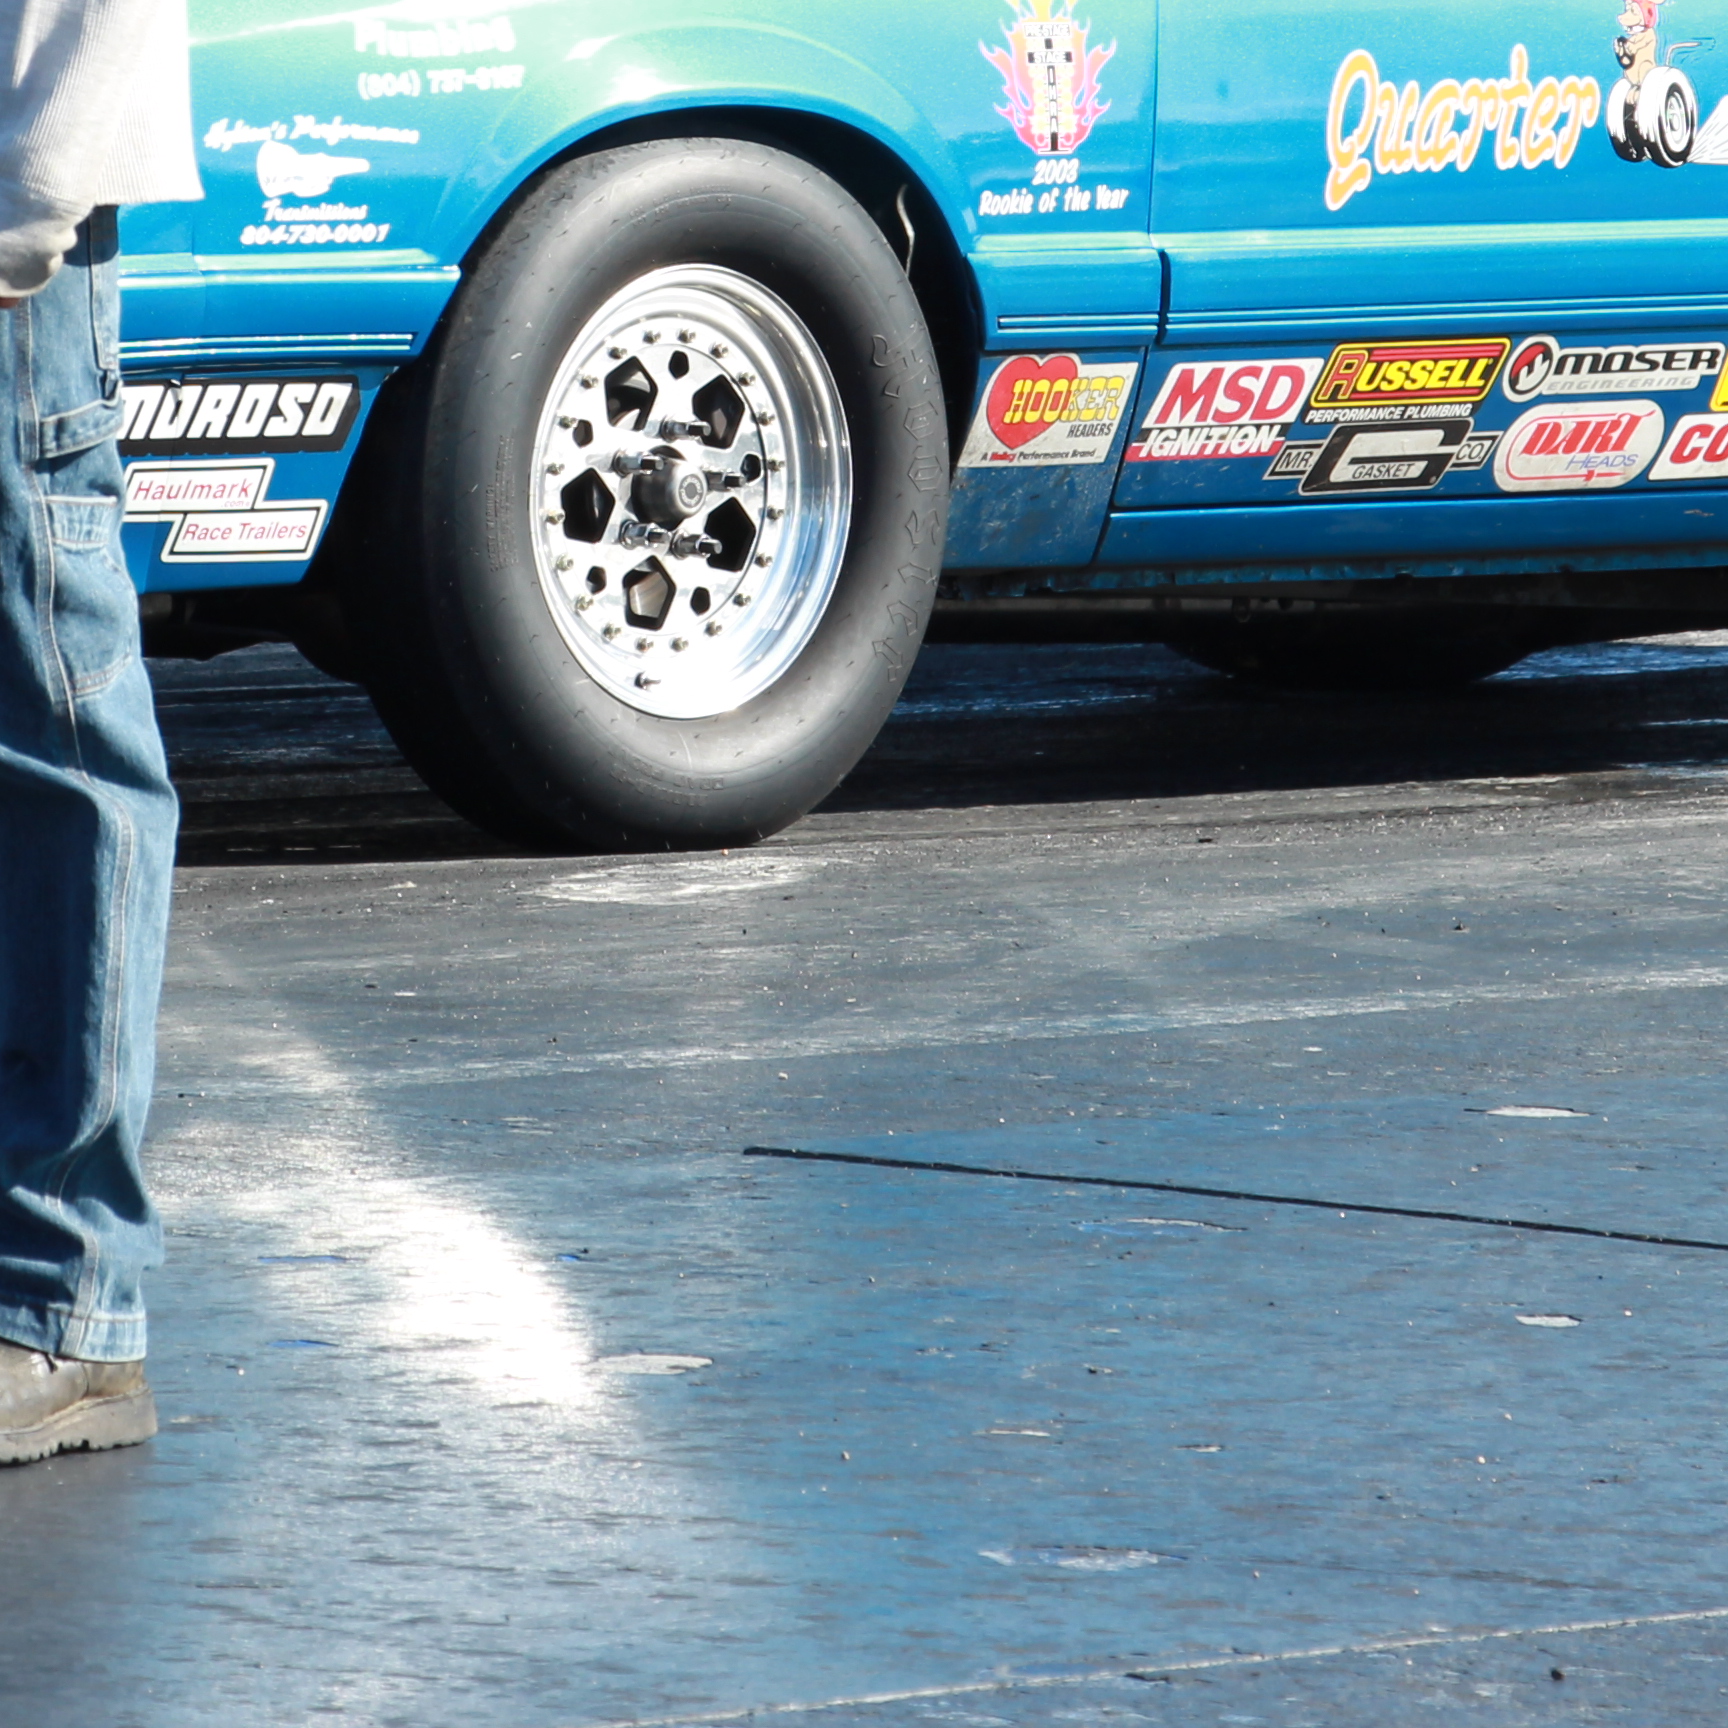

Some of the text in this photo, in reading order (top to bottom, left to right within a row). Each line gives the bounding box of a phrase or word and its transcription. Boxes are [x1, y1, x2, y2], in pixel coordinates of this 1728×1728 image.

[1035, 51, 1066, 64] STAGE
[1325, 42, 1601, 211] Quarter
[1031, 157, 1080, 186] 2003
[978, 184, 1130, 216] Rookie of the Year
[1317, 349, 1492, 401] RUSSELL
[1553, 348, 1722, 376] MOSER
[1153, 365, 1306, 425] MSD
[1546, 375, 1695, 392] ENGINEERING
[1002, 376, 1125, 424] HOOKER
[1304, 403, 1473, 423] PERFORMANCE PLUMBING
[1065, 423, 1114, 439] HEADERS
[1138, 424, 1282, 458] IGNITION
[1519, 410, 1657, 456] DART
[1278, 442, 1483, 480] MR. GASKET CO.
[1565, 453, 1639, 471] HEADS
[132, 478, 254, 501] Haulmark
[181, 522, 308, 542] Race Trailers
